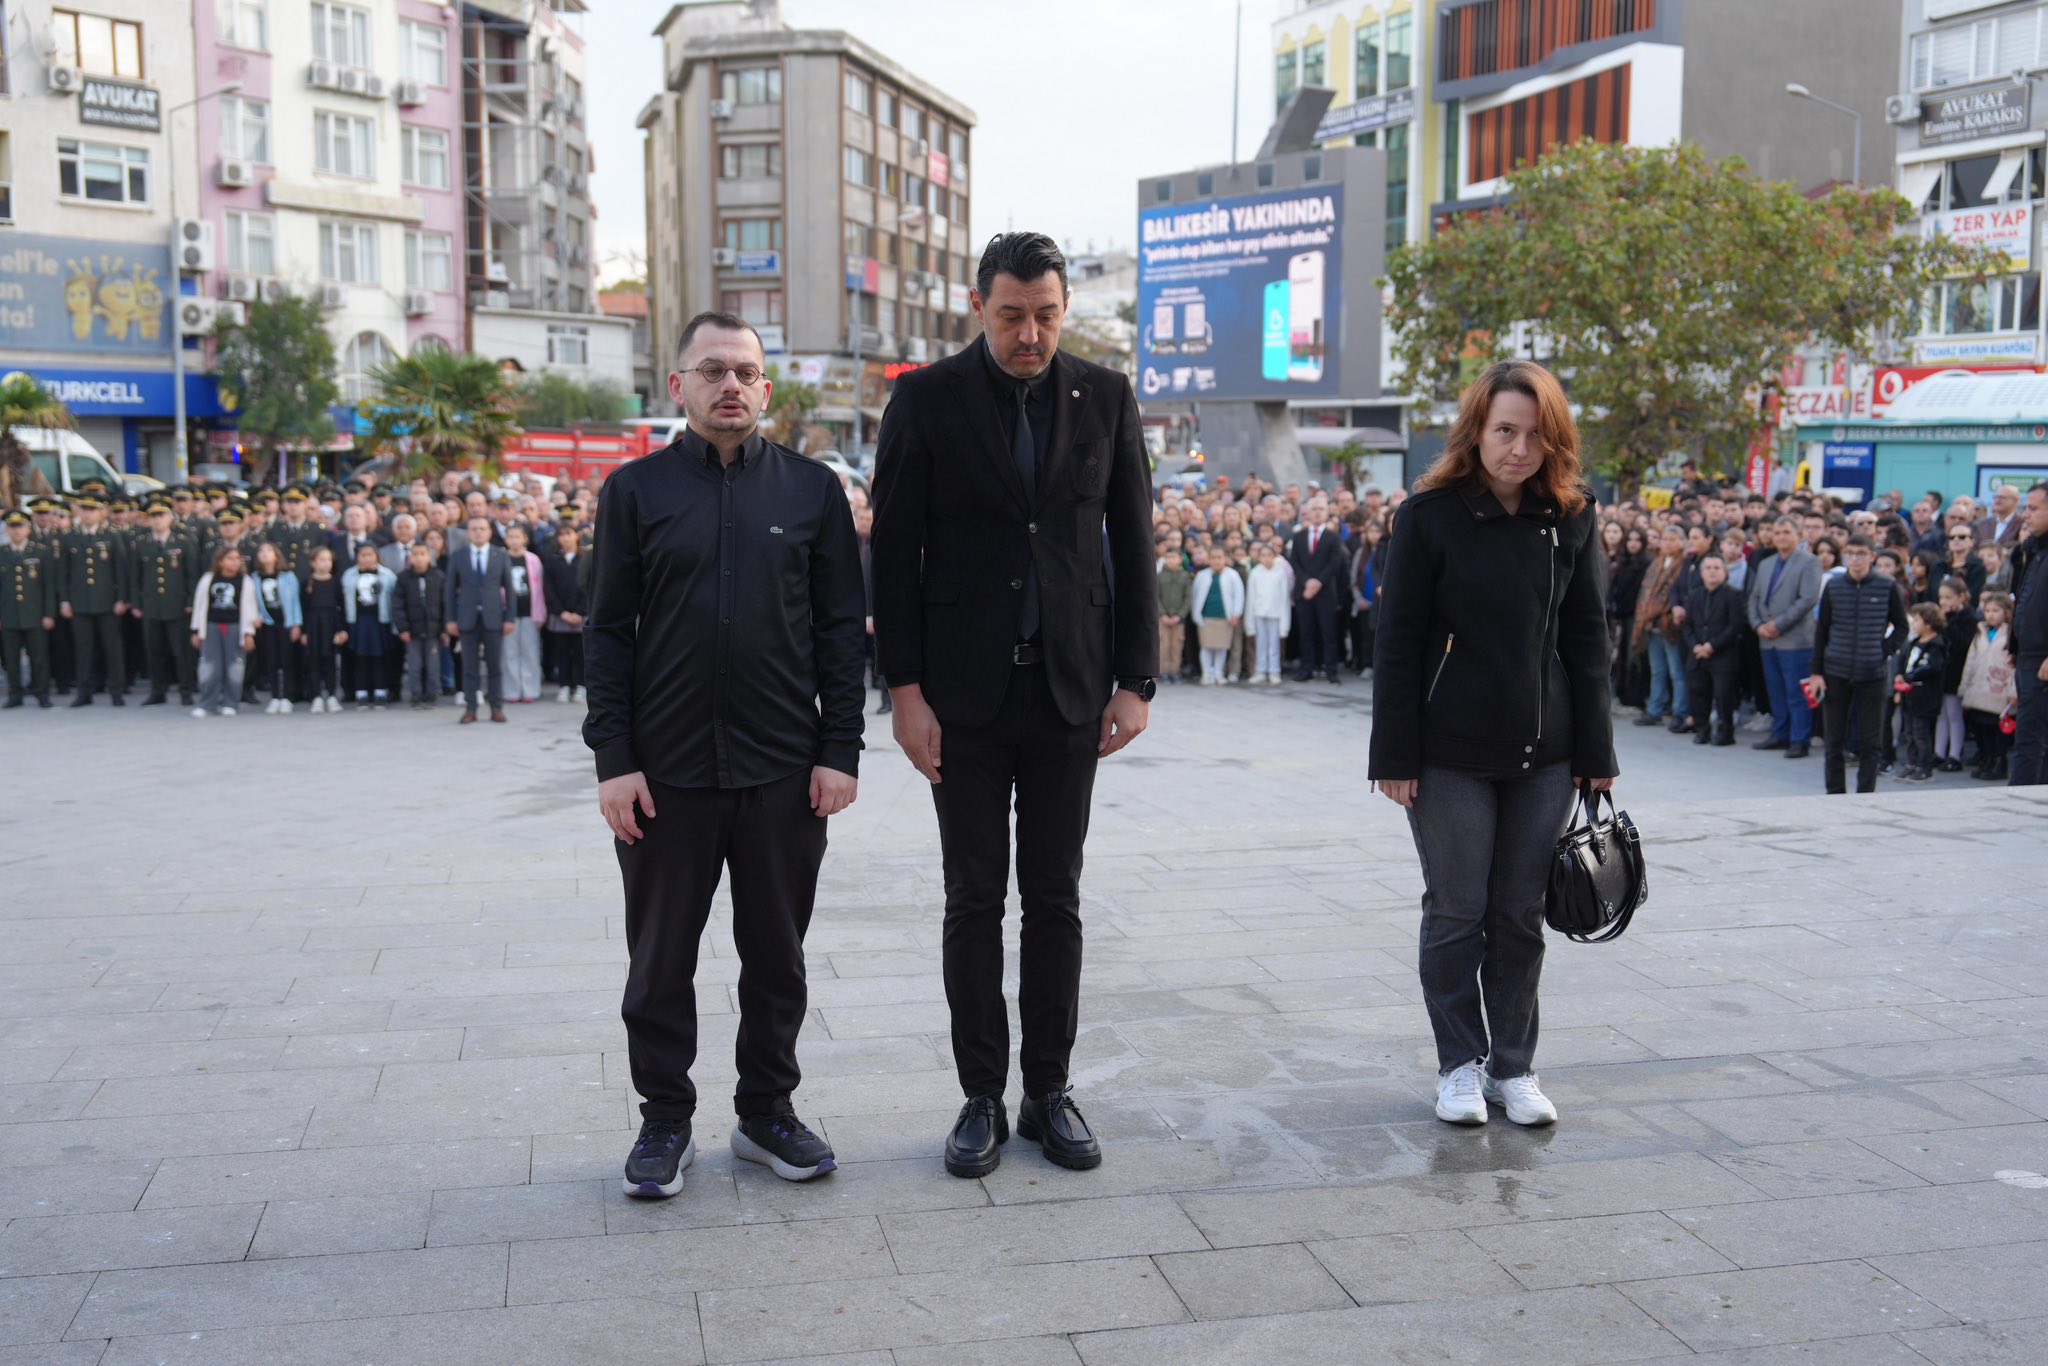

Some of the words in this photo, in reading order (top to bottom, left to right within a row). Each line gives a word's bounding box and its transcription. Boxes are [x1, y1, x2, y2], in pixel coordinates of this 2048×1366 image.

[83, 81, 158, 112] AVUKAT
[1941, 90, 2008, 118] AVUKAT
[1143, 203, 1230, 243] BALIKESİR
[1232, 196, 1336, 233] YAKININDA
[1952, 213, 1985, 233] ZER
[1991, 207, 2027, 228] YAP
[42, 379, 145, 404] TURKCELL
